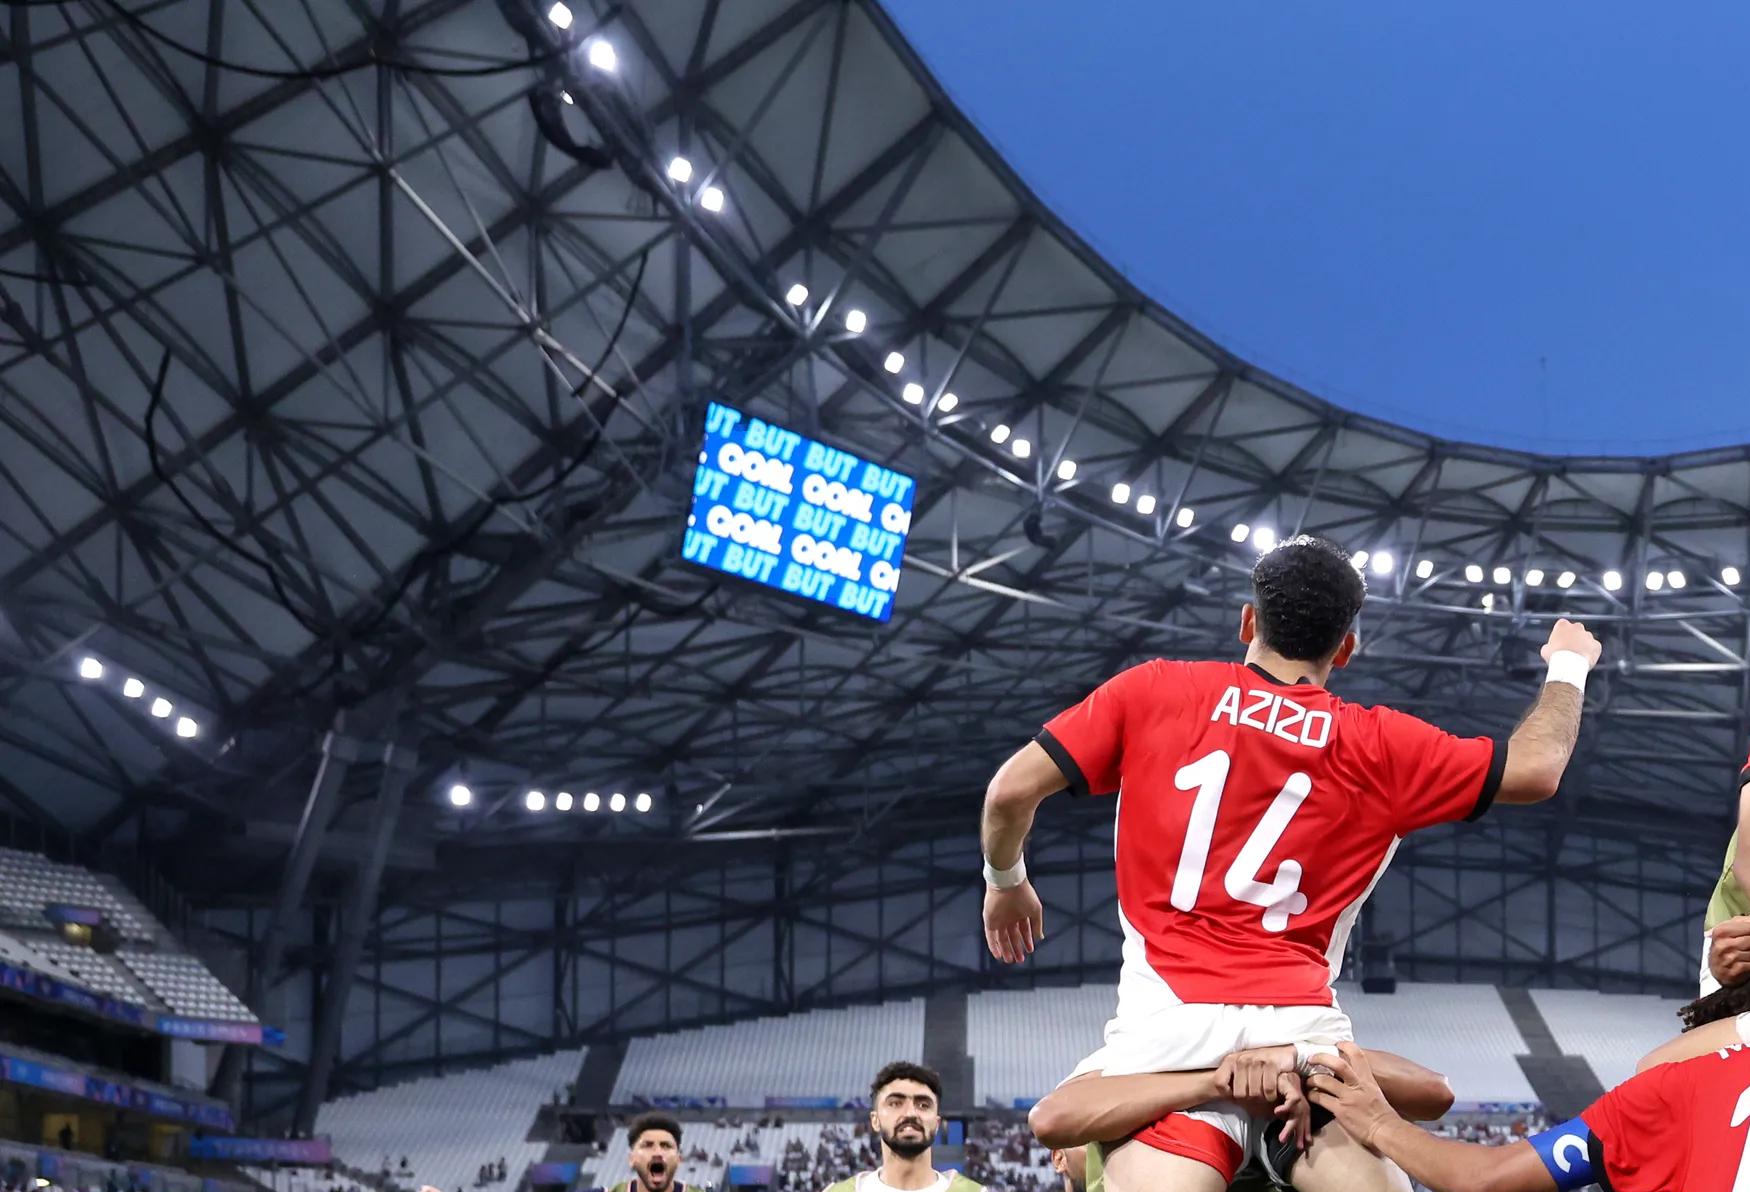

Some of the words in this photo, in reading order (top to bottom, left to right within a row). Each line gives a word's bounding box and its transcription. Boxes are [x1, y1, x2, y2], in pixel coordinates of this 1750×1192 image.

[705, 401, 741, 437] UT
[745, 418, 801, 460] BUT
[804, 441, 858, 482] BUT
[861, 463, 913, 501] BUT
[694, 467, 730, 500] UT
[733, 482, 790, 521] BUT
[793, 503, 846, 542] BUT
[850, 523, 901, 560] BUT
[682, 529, 718, 564] UT
[721, 543, 778, 583] BUT
[781, 562, 836, 601] BUT
[838, 581, 890, 618] BUT
[1210, 685, 1333, 749] AZIZO
[1170, 749, 1312, 932] 14
[1552, 1133, 1590, 1173] C
